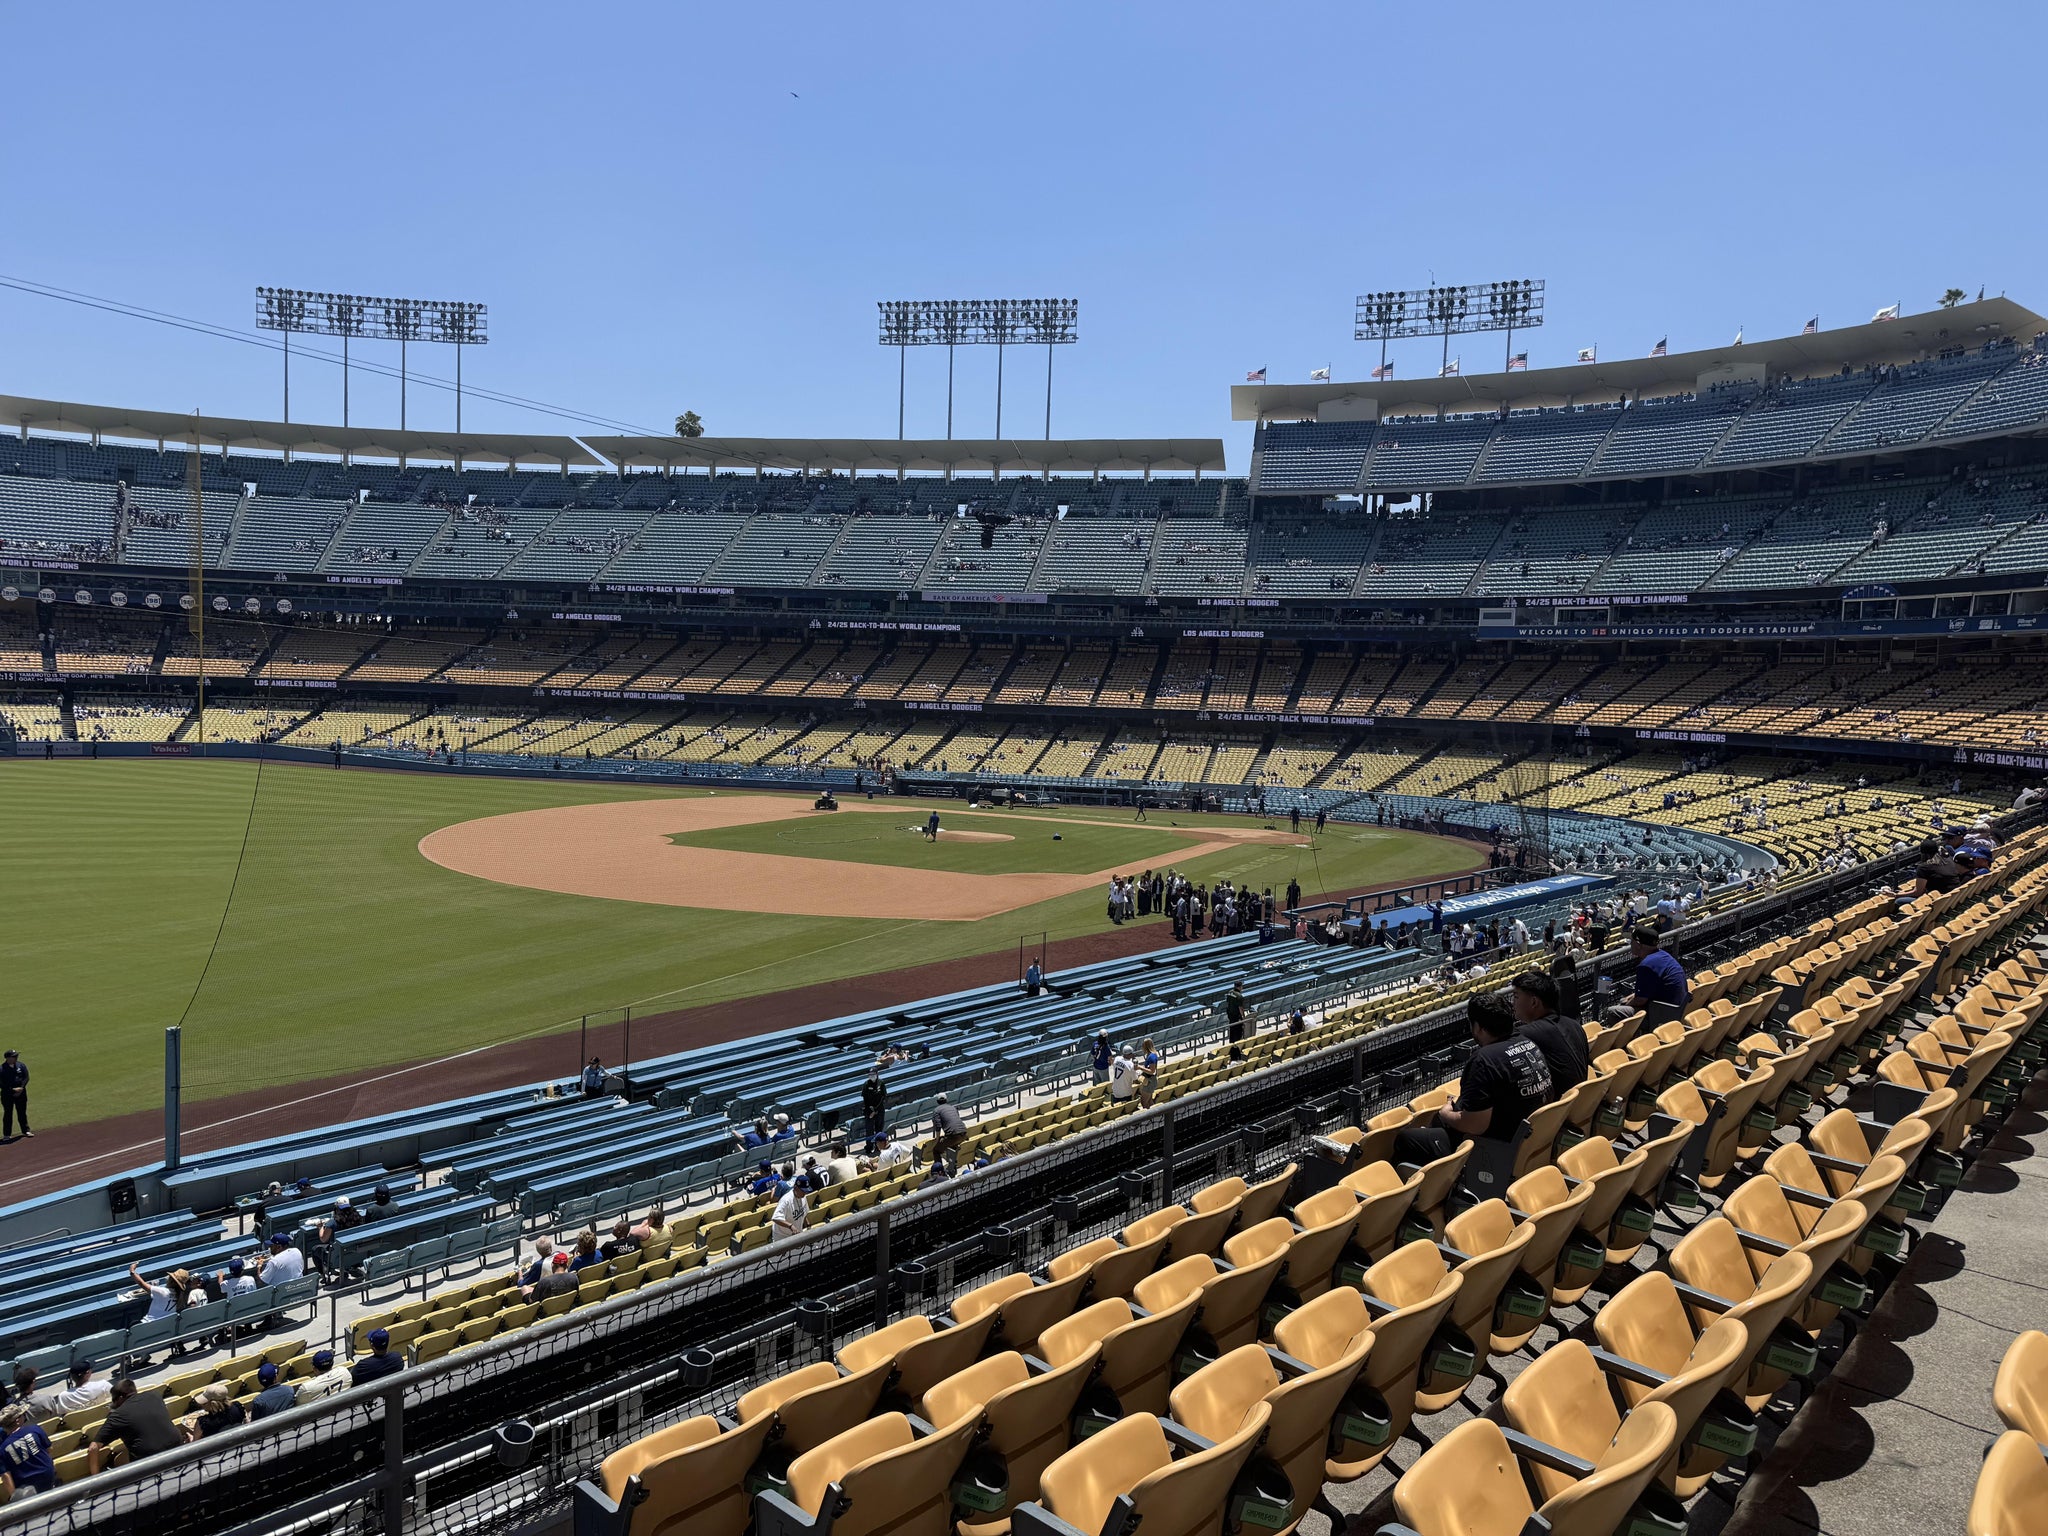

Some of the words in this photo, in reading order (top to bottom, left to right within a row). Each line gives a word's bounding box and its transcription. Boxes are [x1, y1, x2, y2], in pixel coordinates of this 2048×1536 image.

[0, 559, 29, 567] WORLD
[32, 561, 79, 570] CHAMPIONS
[1552, 597, 1609, 605] BACK-TO-BACK
[1642, 595, 1688, 603] CHAMPIONS
[1244, 714, 1299, 722] BACK-TO-BACK
[1330, 717, 1374, 725] CHAMPIONS
[1636, 730, 1650, 738] LOS
[1653, 731, 1688, 740] ANGELES
[1690, 733, 1726, 742] DODGERS
[1974, 752, 1995, 763] 24/25
[1997, 755, 2043, 769] BACK-TO-BACK
[1505, 1045, 1526, 1056] WORLD
[5, 1438, 29, 1465] 17
